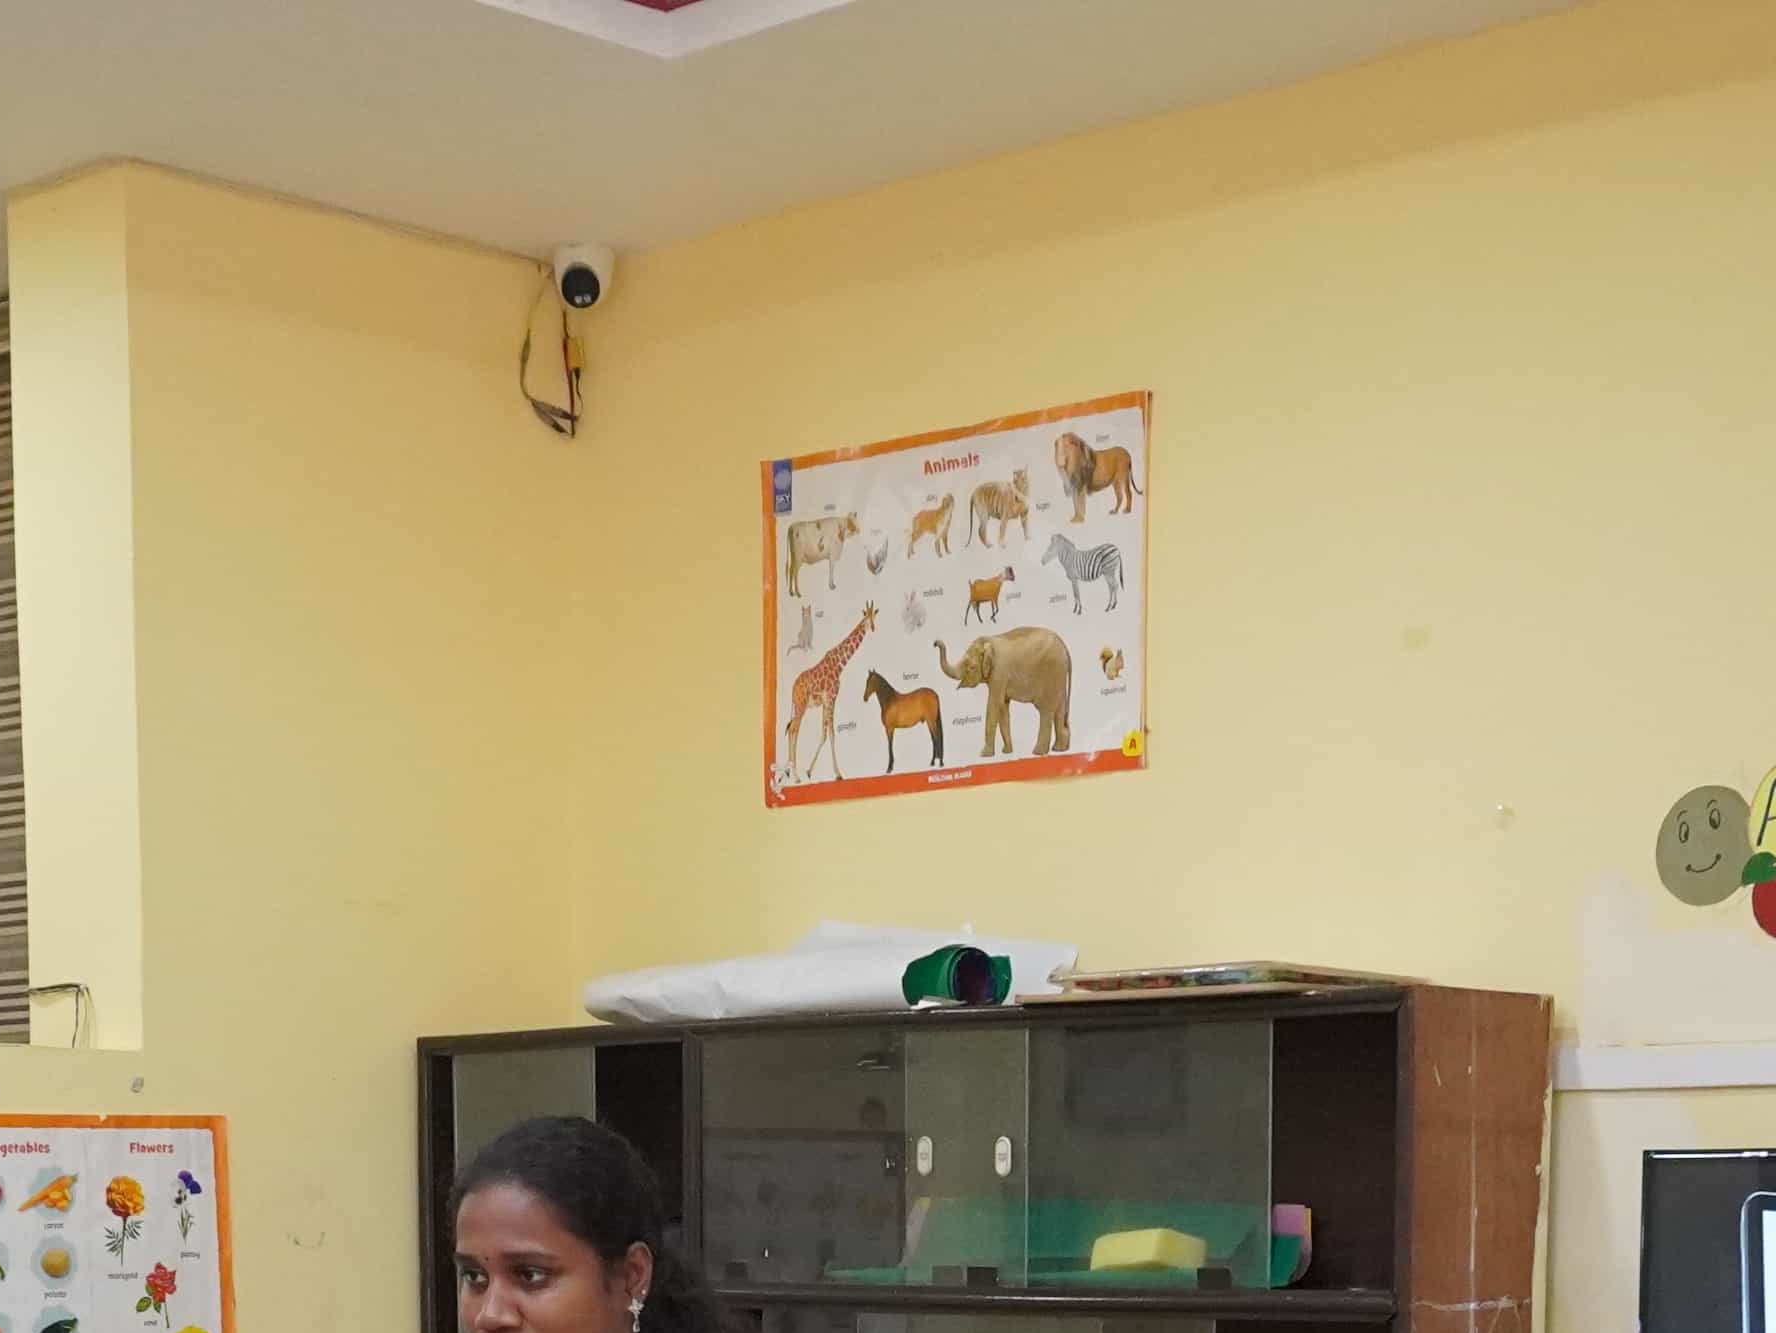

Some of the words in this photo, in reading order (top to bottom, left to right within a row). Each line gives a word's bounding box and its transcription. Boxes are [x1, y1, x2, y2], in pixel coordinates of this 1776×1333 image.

[924, 452, 981, 476] Animals
[1129, 738, 1137, 750] A
[129, 1142, 174, 1153] Flowers
